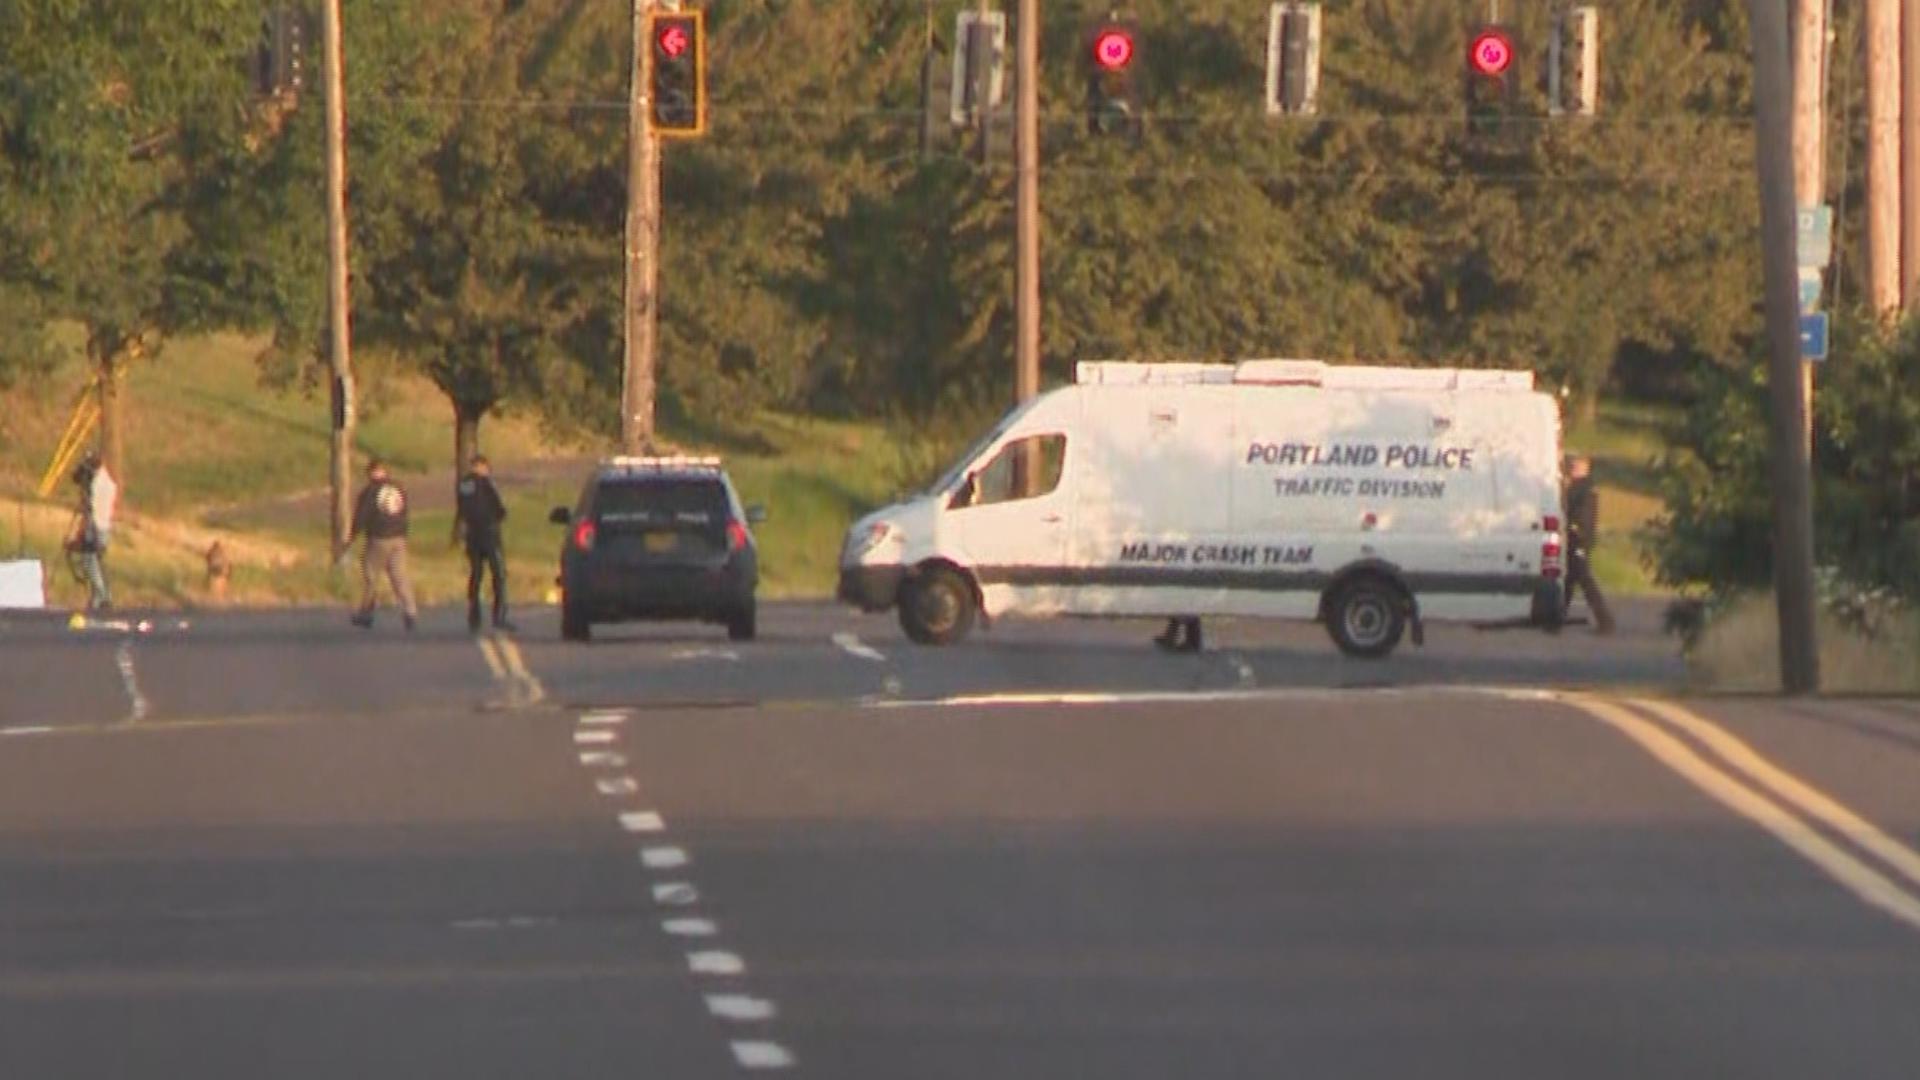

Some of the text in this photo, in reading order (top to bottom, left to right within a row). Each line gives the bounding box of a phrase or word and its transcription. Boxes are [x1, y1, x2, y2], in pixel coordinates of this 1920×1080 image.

[1246, 443, 1474, 469] PORTLAND POLICE
[1274, 478, 1446, 499] TRAFFIC DIVISION
[1120, 543, 1314, 564] MAJOR CRASH TEAM
